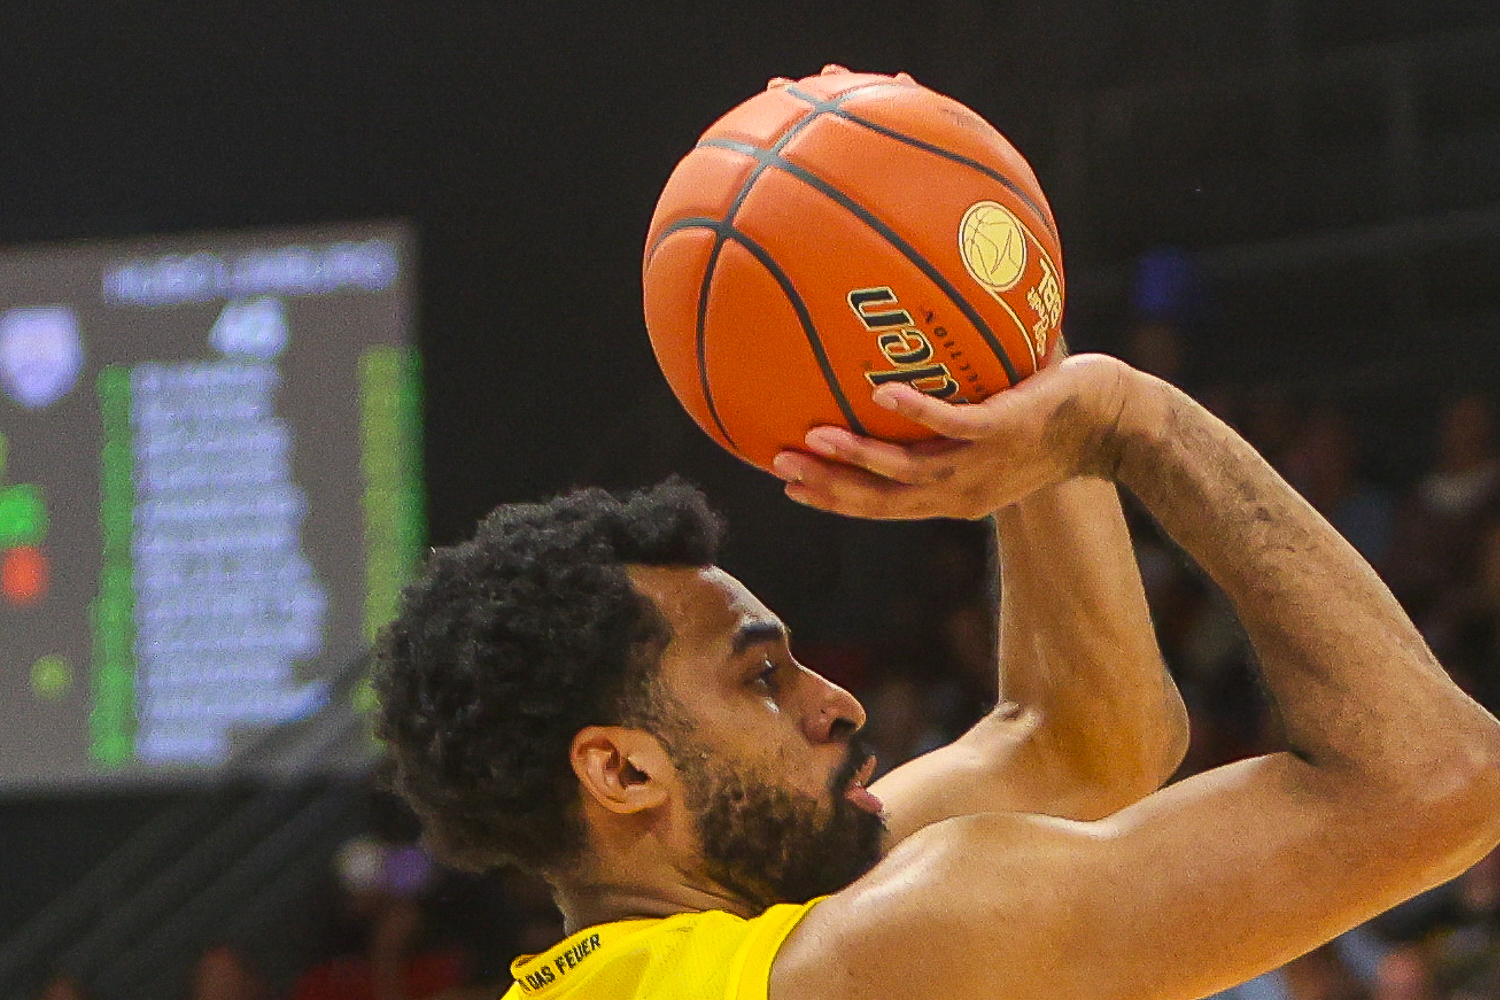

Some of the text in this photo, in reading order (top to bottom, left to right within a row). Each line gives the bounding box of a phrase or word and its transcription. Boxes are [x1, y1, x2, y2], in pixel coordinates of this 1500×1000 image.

[847, 286, 968, 404] den
[525, 965, 556, 991] DAS
[554, 933, 601, 975] FEUER
